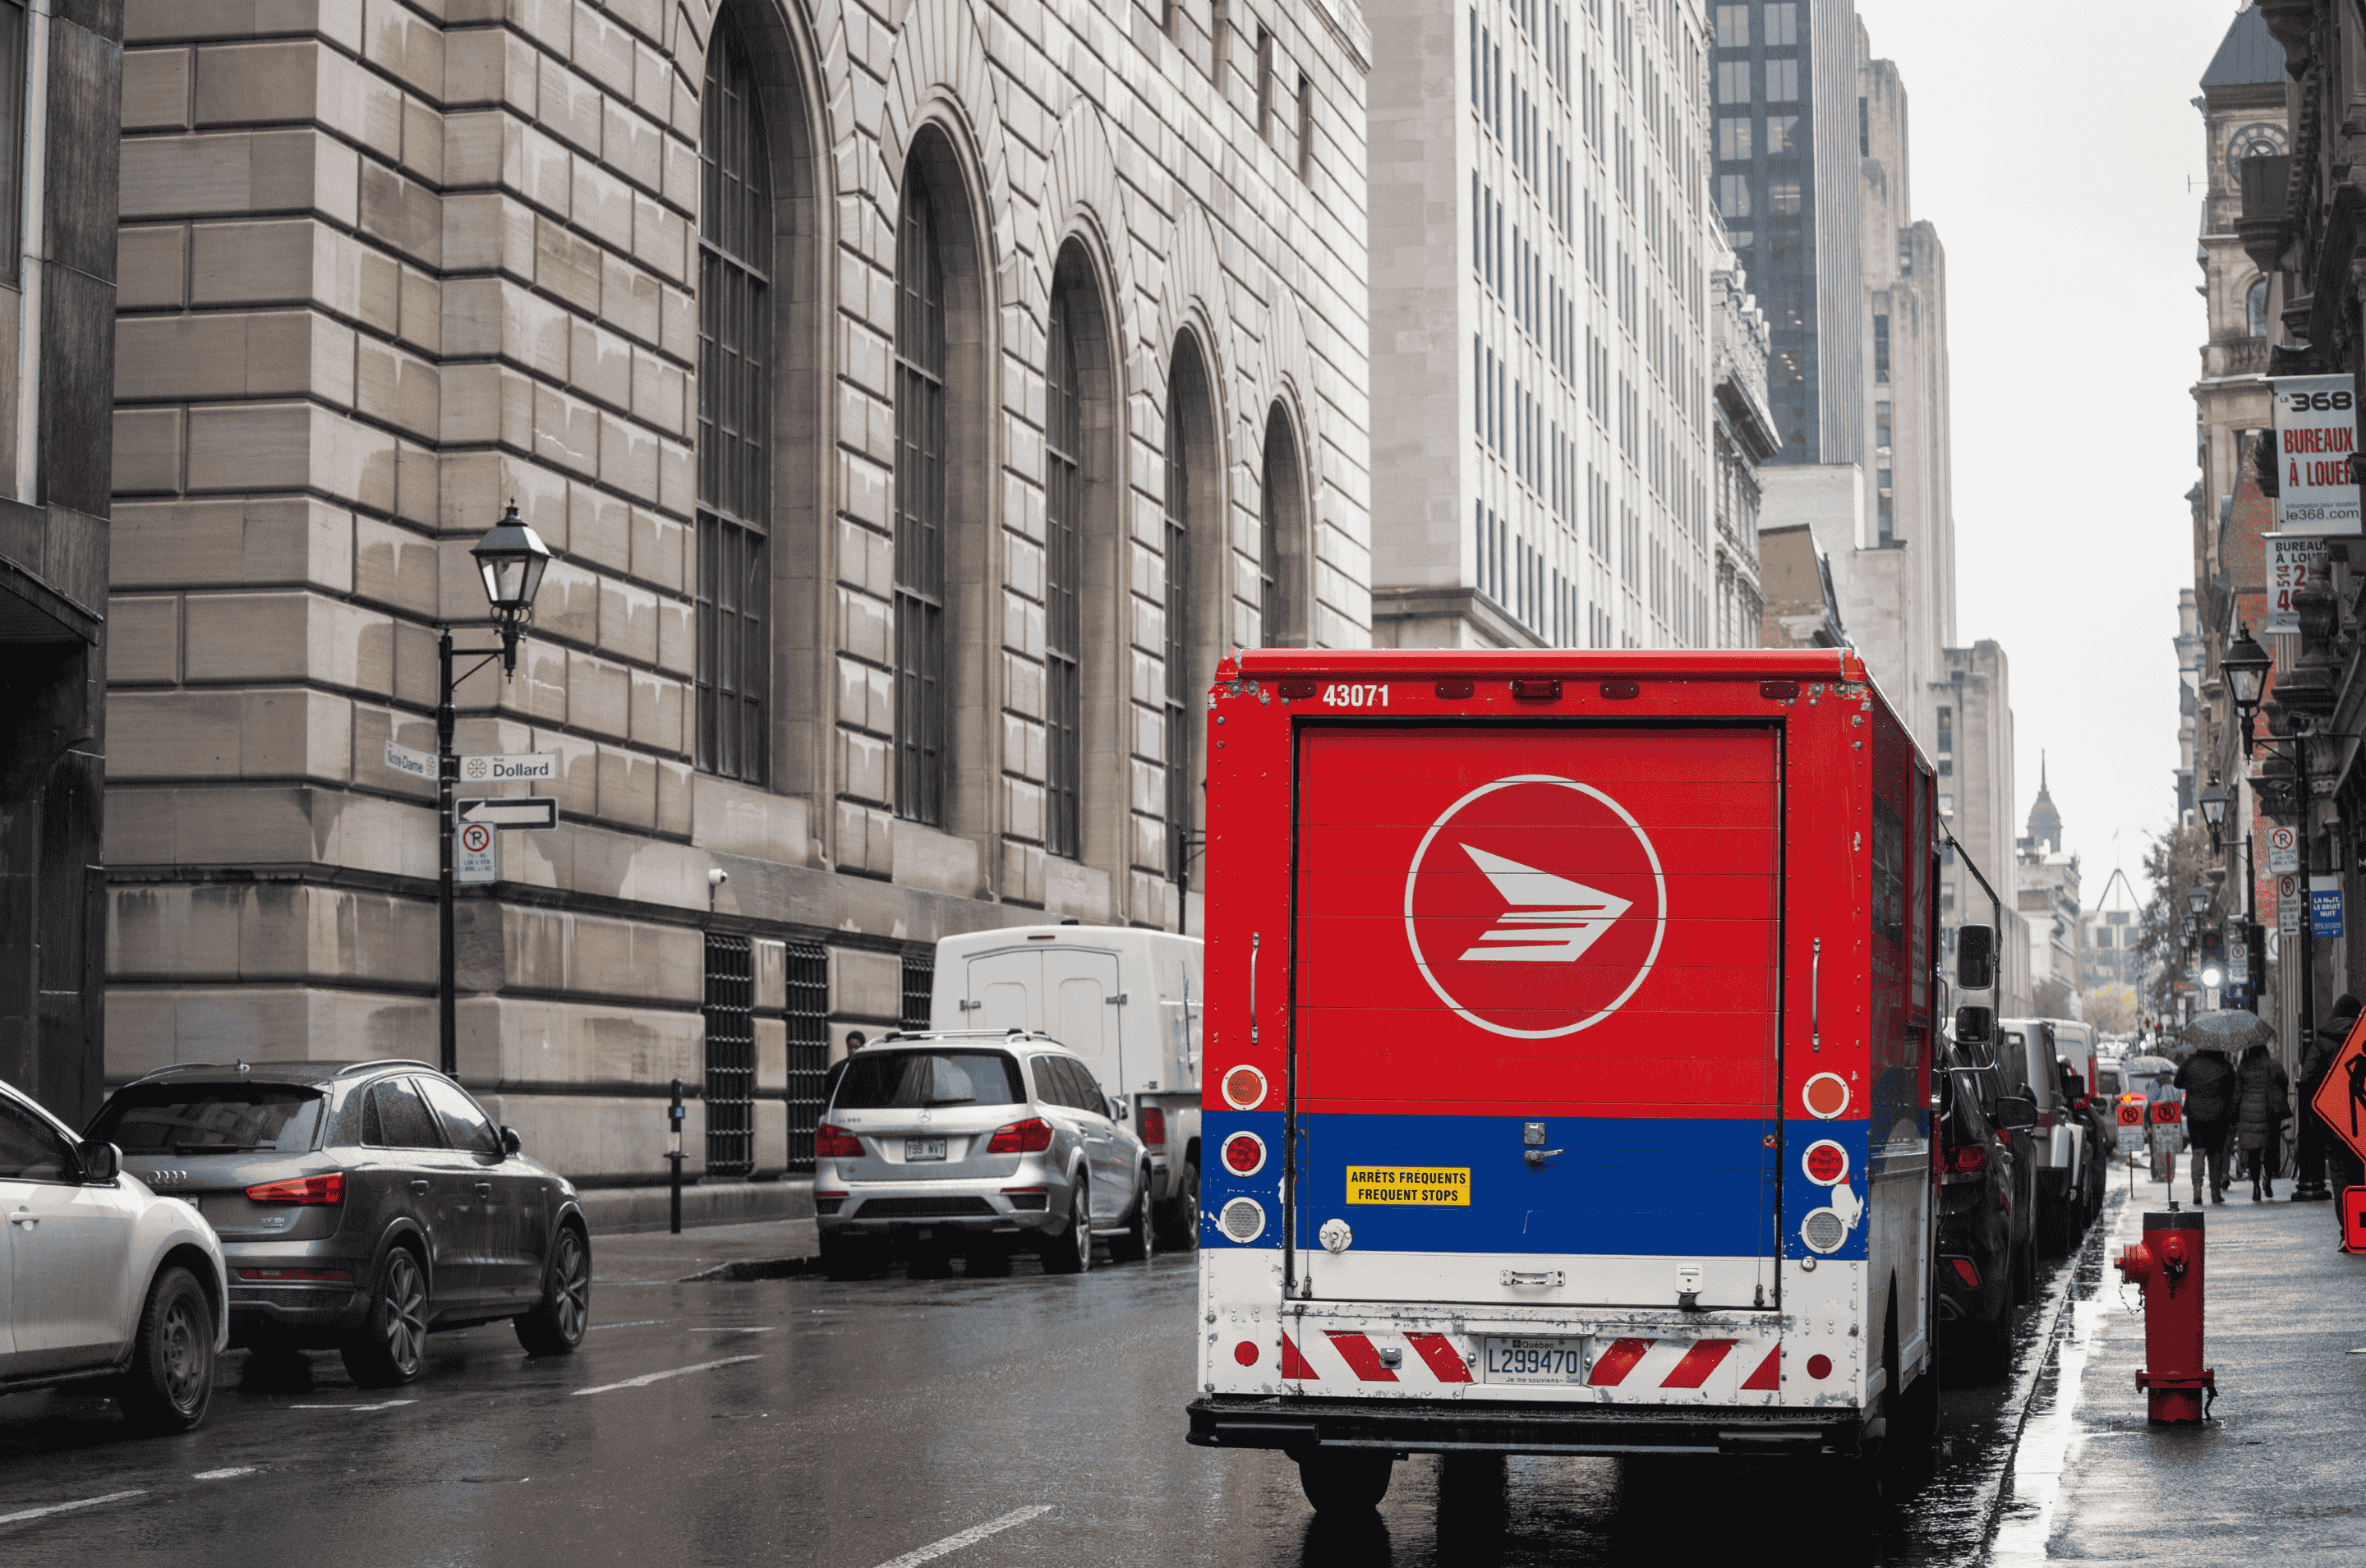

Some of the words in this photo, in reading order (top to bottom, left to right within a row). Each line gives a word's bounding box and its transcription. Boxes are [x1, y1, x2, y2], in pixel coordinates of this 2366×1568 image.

[2289, 391, 2353, 412] 368
[2284, 427, 2354, 454] BUREAUX
[2289, 458, 2299, 487] À
[2286, 508, 2359, 521] le368.com
[1323, 684, 1388, 706] 43071
[494, 762, 549, 777] Dollard
[1351, 1169, 1395, 1183] ARRÊTS
[1399, 1170, 1466, 1184] FRÉQUENTS
[1358, 1189, 1418, 1202] FREQUENT
[1421, 1190, 1458, 1202] STOPS
[1521, 1340, 1555, 1349] Québec
[1489, 1349, 1577, 1374] L299470
